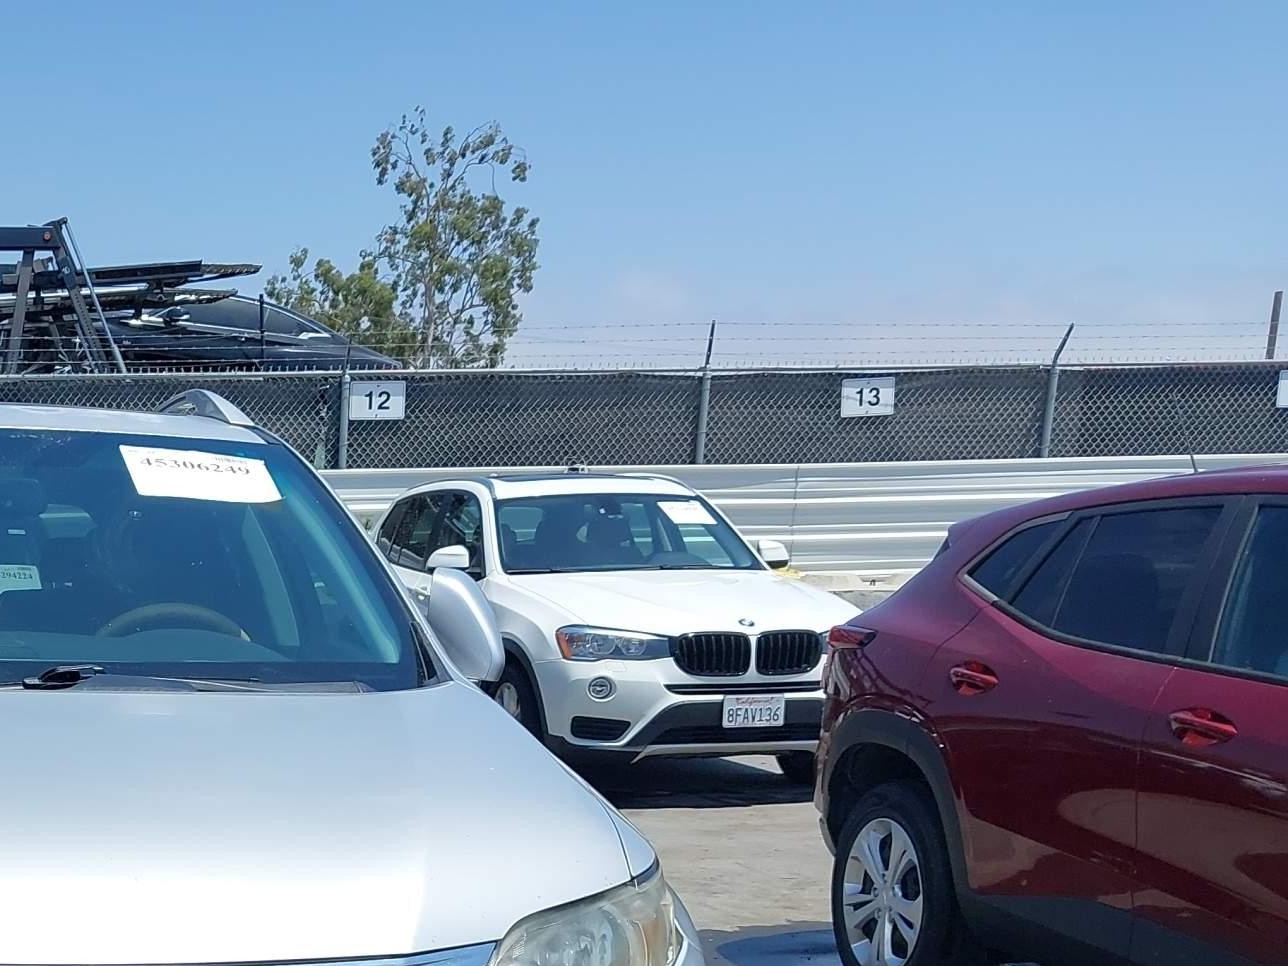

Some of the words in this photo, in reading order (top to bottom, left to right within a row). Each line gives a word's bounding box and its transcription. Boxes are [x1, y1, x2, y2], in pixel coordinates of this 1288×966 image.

[363, 390, 391, 410] 12
[855, 386, 881, 407] 13
[727, 706, 782, 724] 8FAV136
